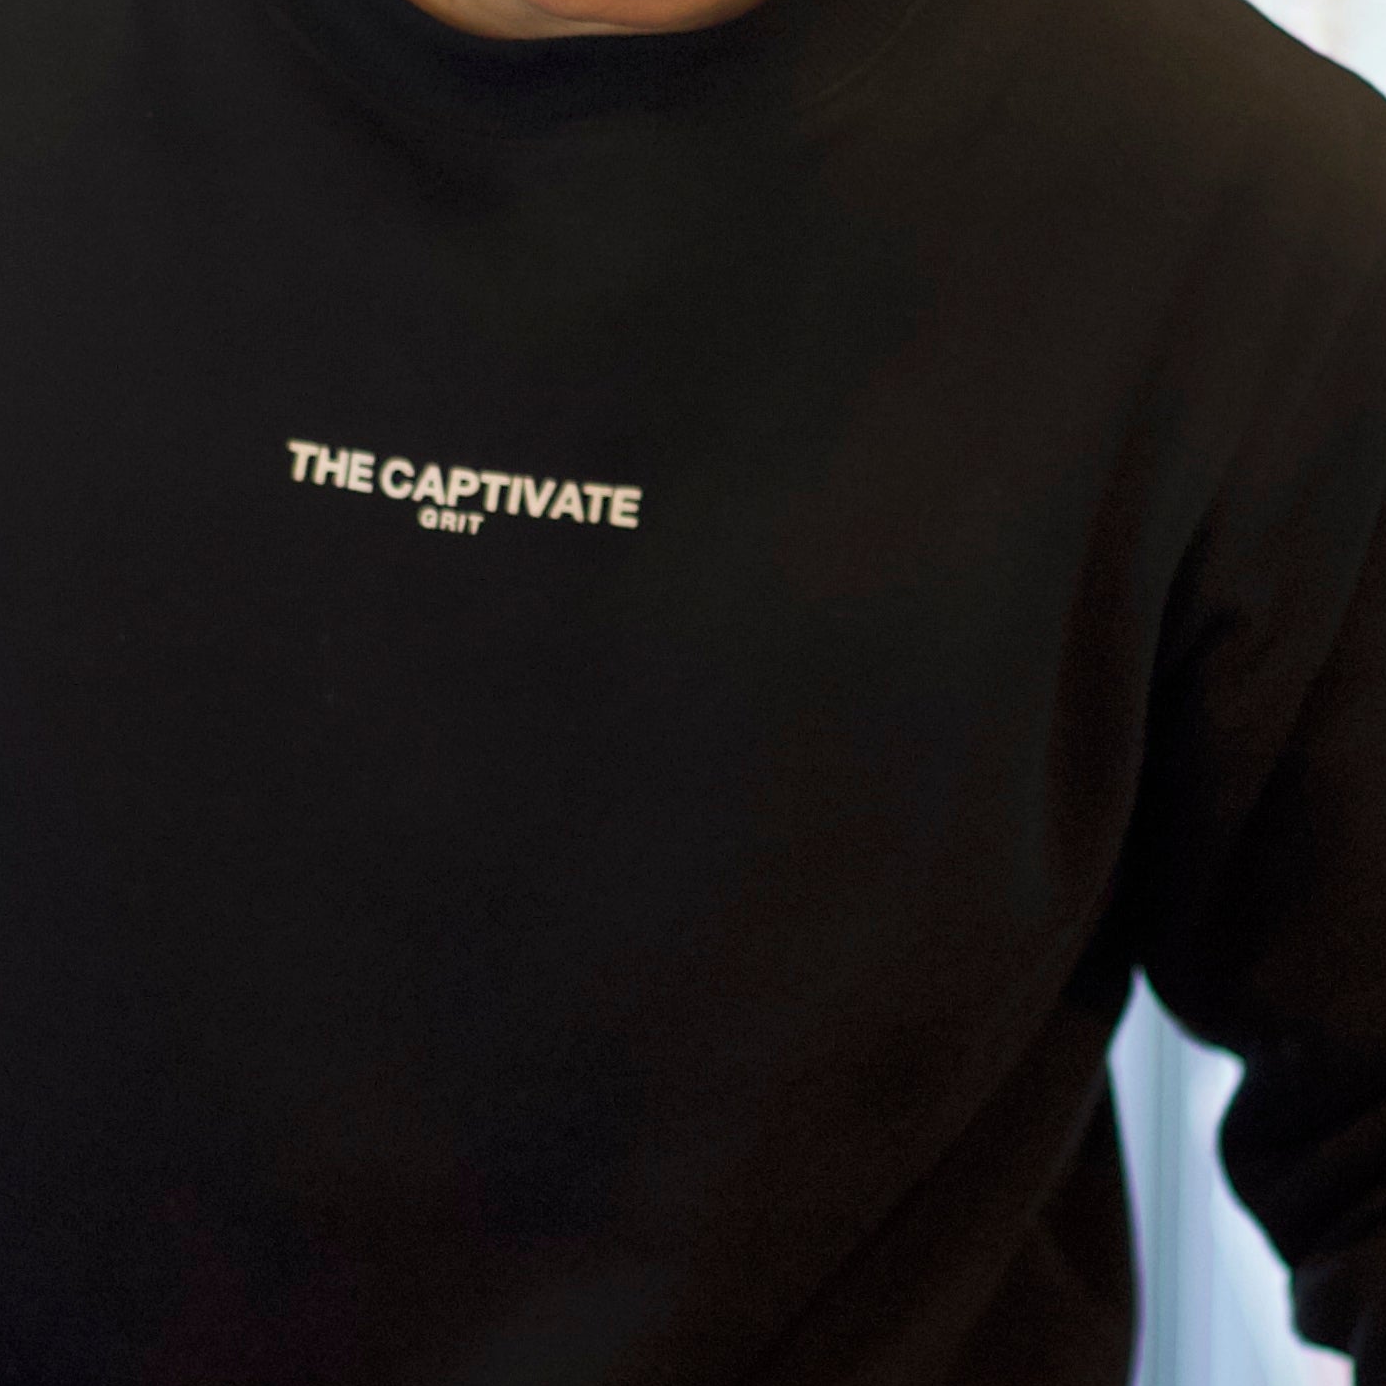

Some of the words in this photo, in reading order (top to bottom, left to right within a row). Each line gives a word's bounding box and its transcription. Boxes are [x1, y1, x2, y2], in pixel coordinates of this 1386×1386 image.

[287, 439, 376, 494] THE
[379, 457, 642, 529] CAPTIVATE
[418, 505, 485, 535] GRIT
